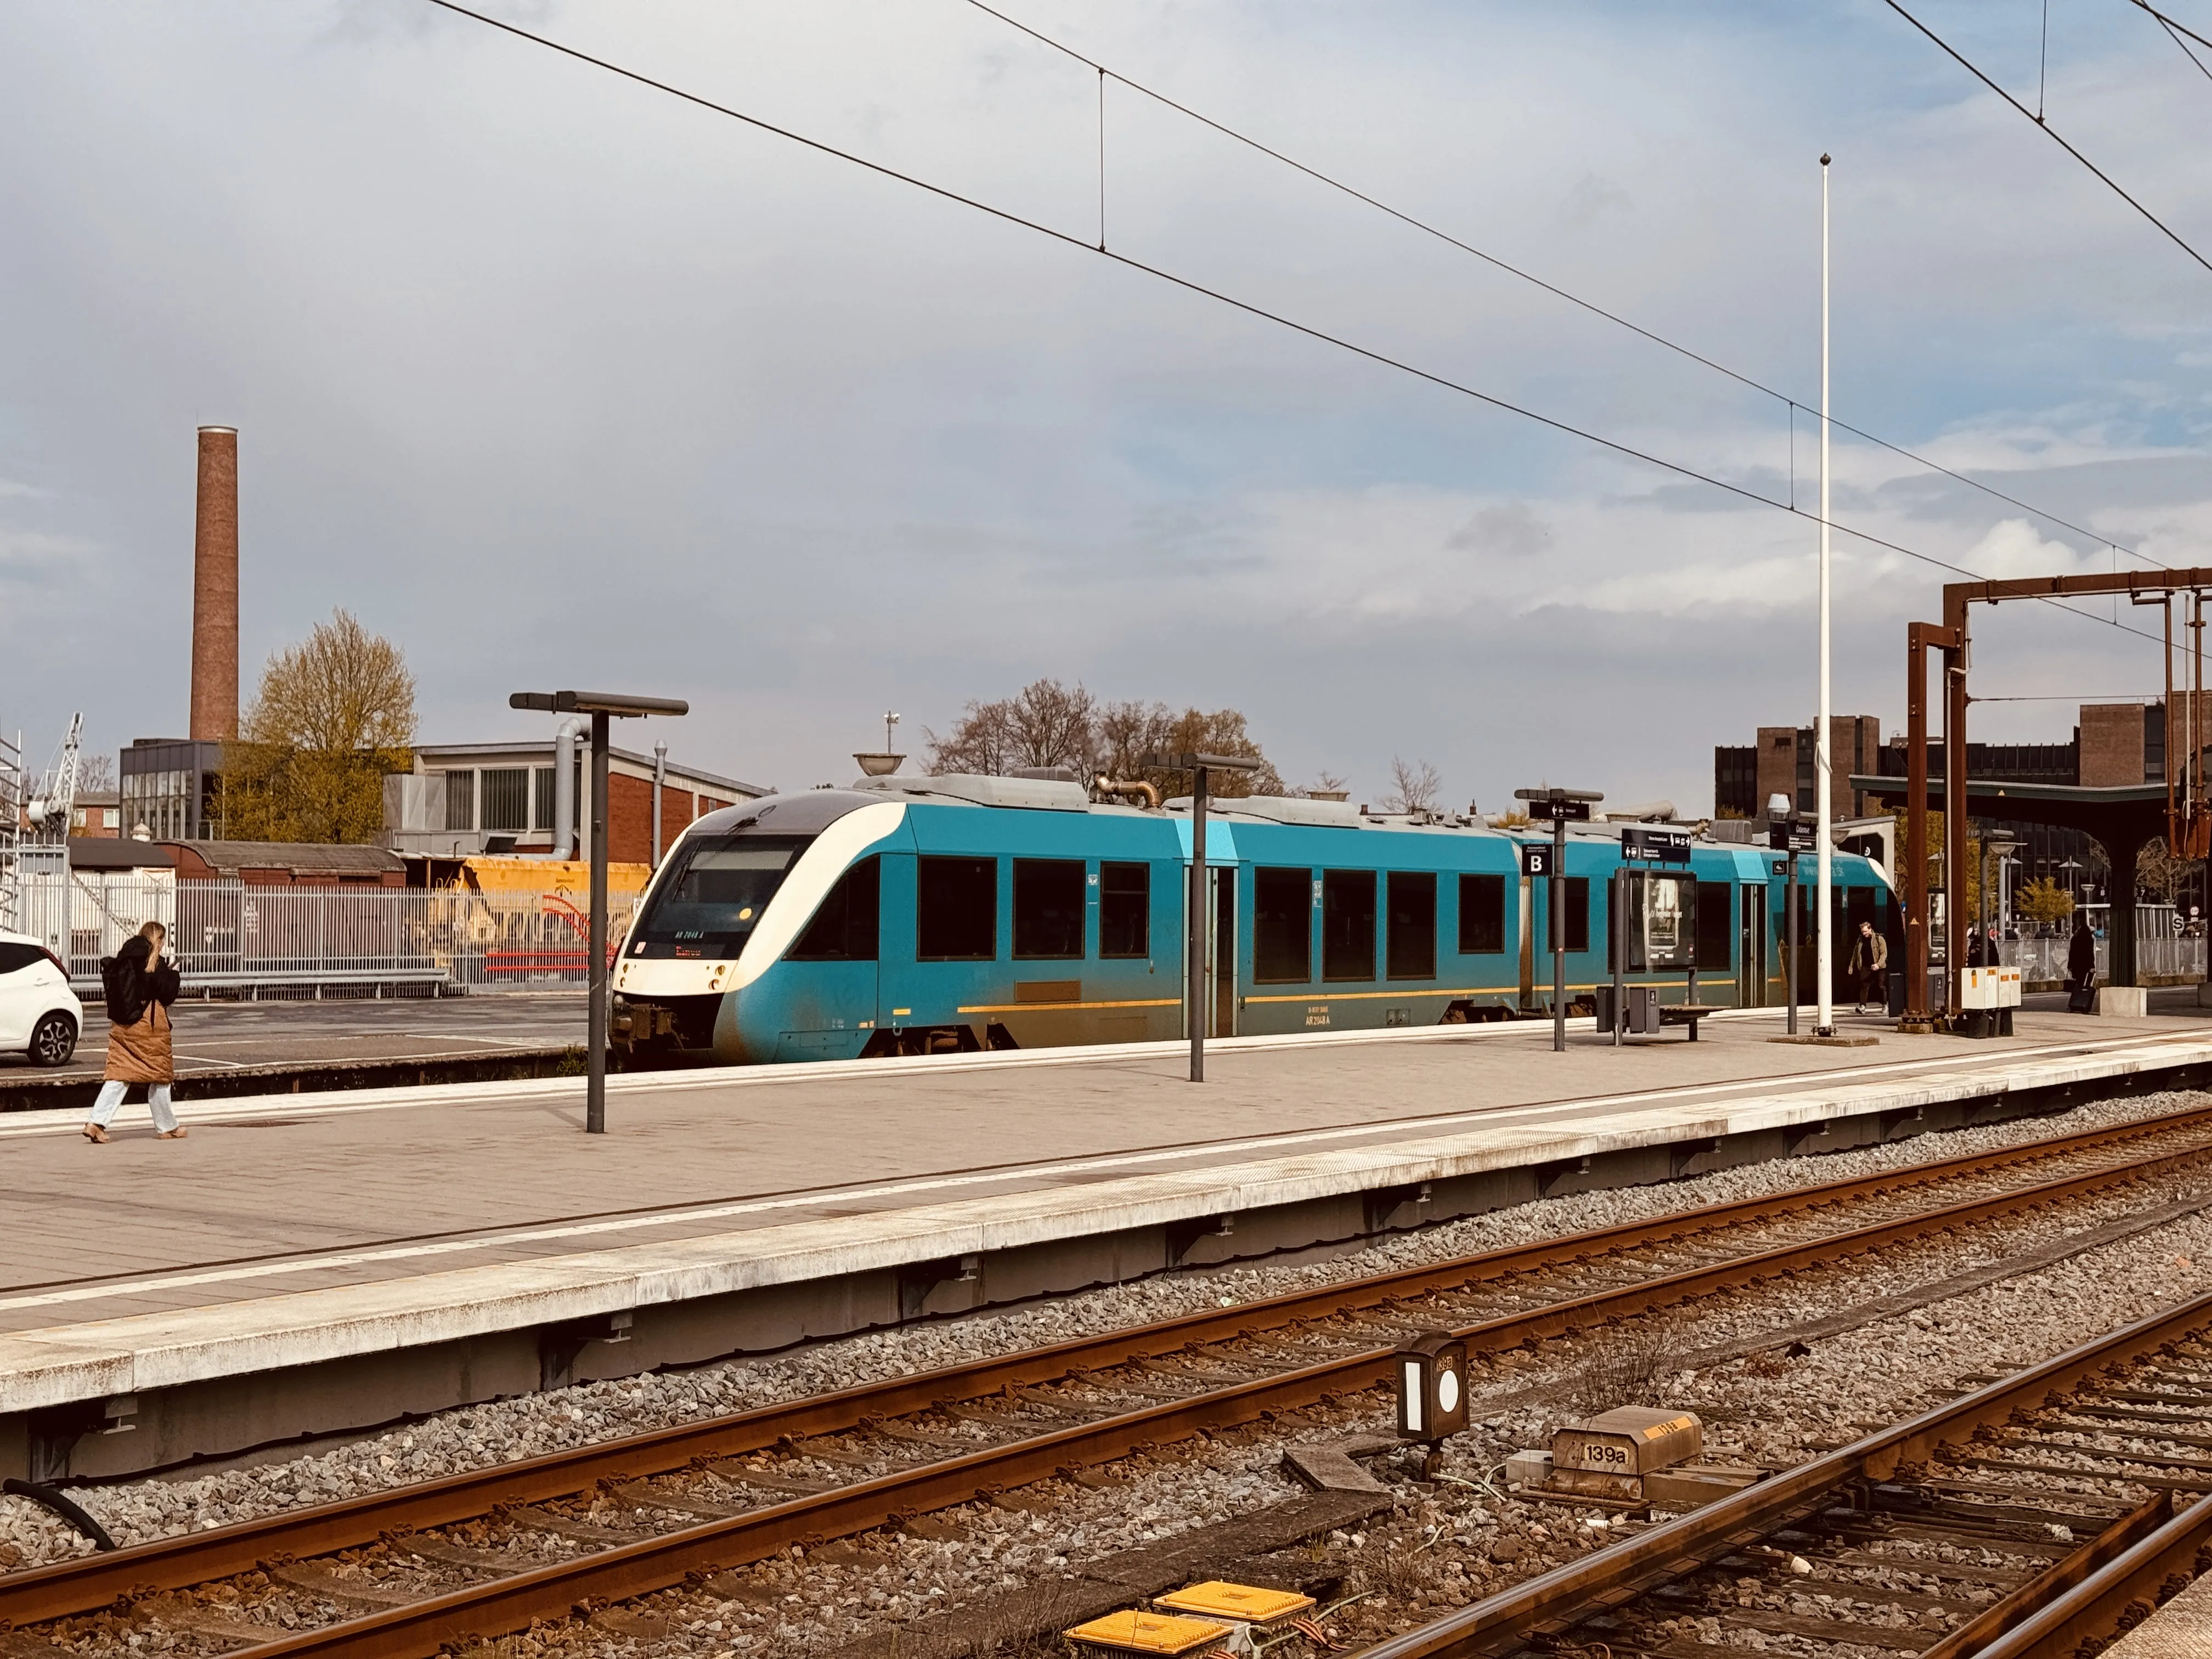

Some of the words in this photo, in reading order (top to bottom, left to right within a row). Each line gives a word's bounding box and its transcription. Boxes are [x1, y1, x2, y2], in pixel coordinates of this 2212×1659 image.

[1531, 855, 1542, 872] B
[2173, 918, 2183, 929] S
[1436, 1356, 1452, 1371] 139a
[1658, 1422, 1679, 1436] 139a
[1587, 1445, 1626, 1464] 139a
